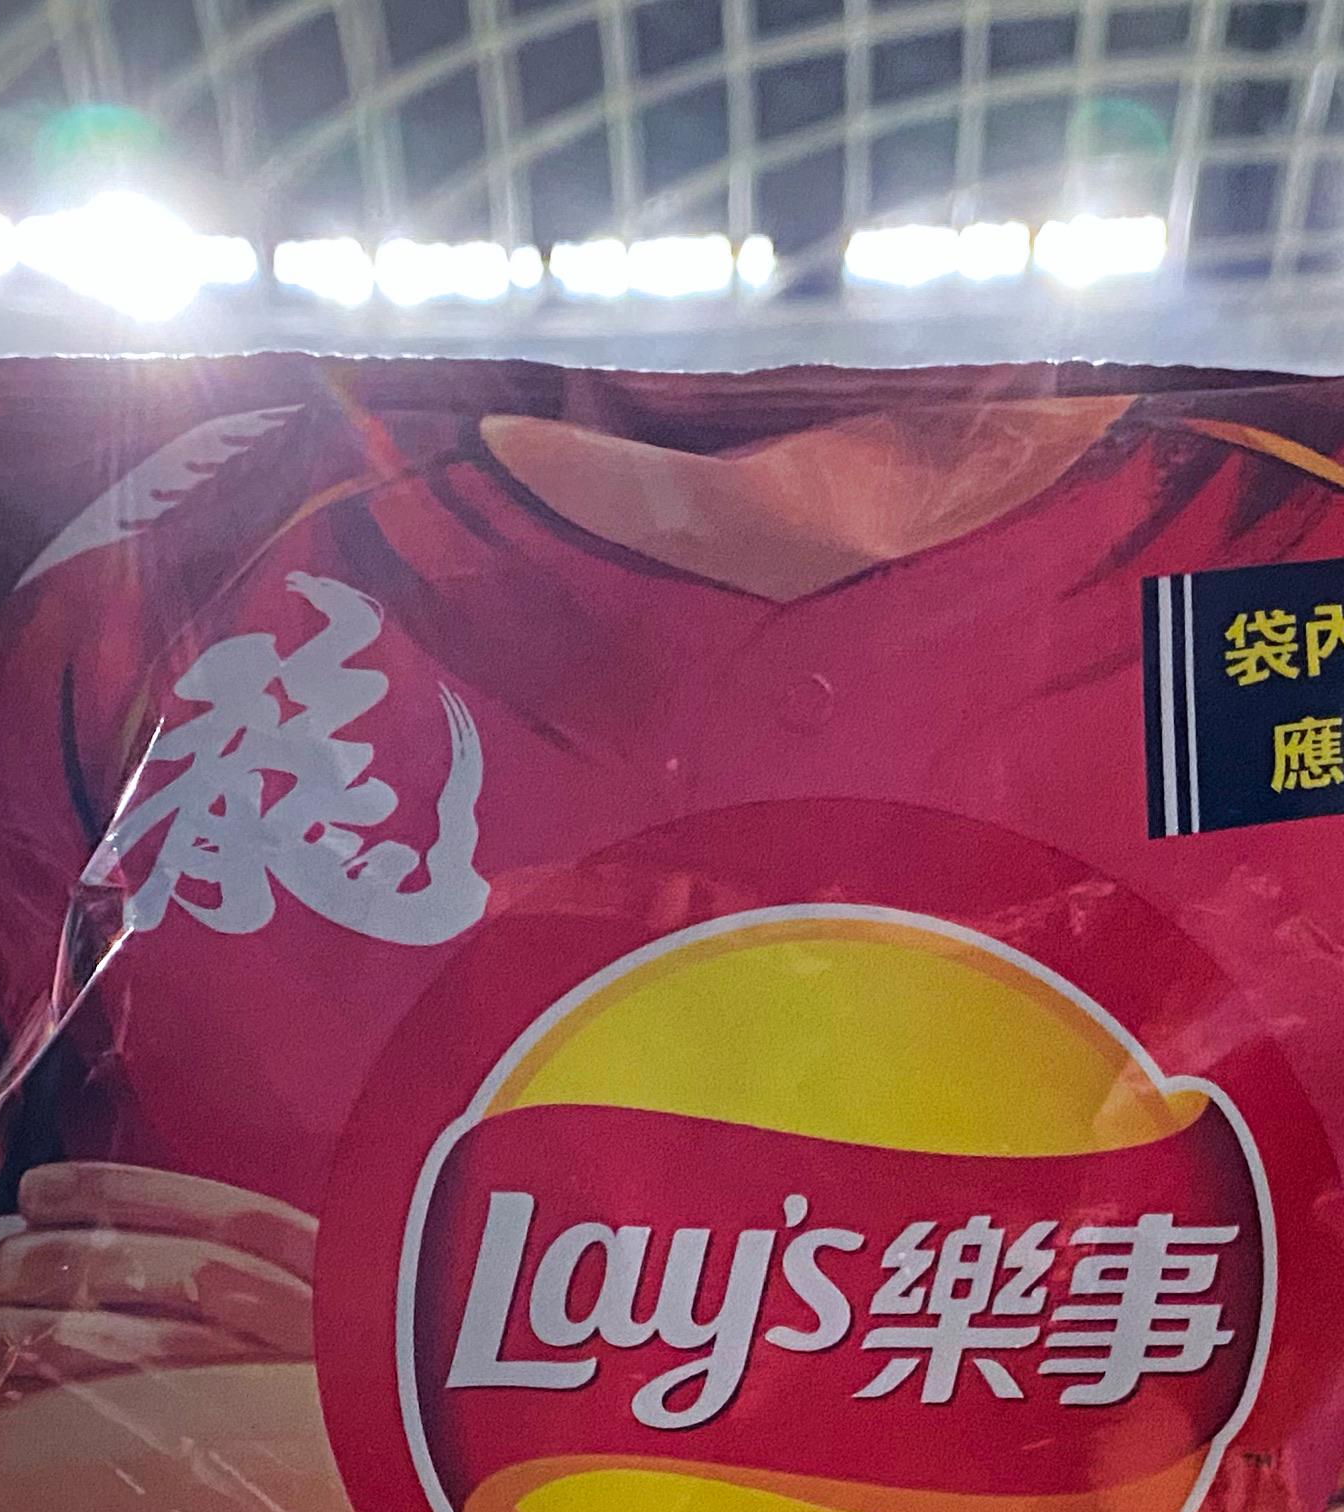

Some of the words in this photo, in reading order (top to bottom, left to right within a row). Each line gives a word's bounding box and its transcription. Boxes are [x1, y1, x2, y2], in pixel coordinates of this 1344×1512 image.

[80, 570, 491, 946] 龍
[445, 1191, 861, 1429] Lay's
[853, 1212, 1240, 1405] 樂事
